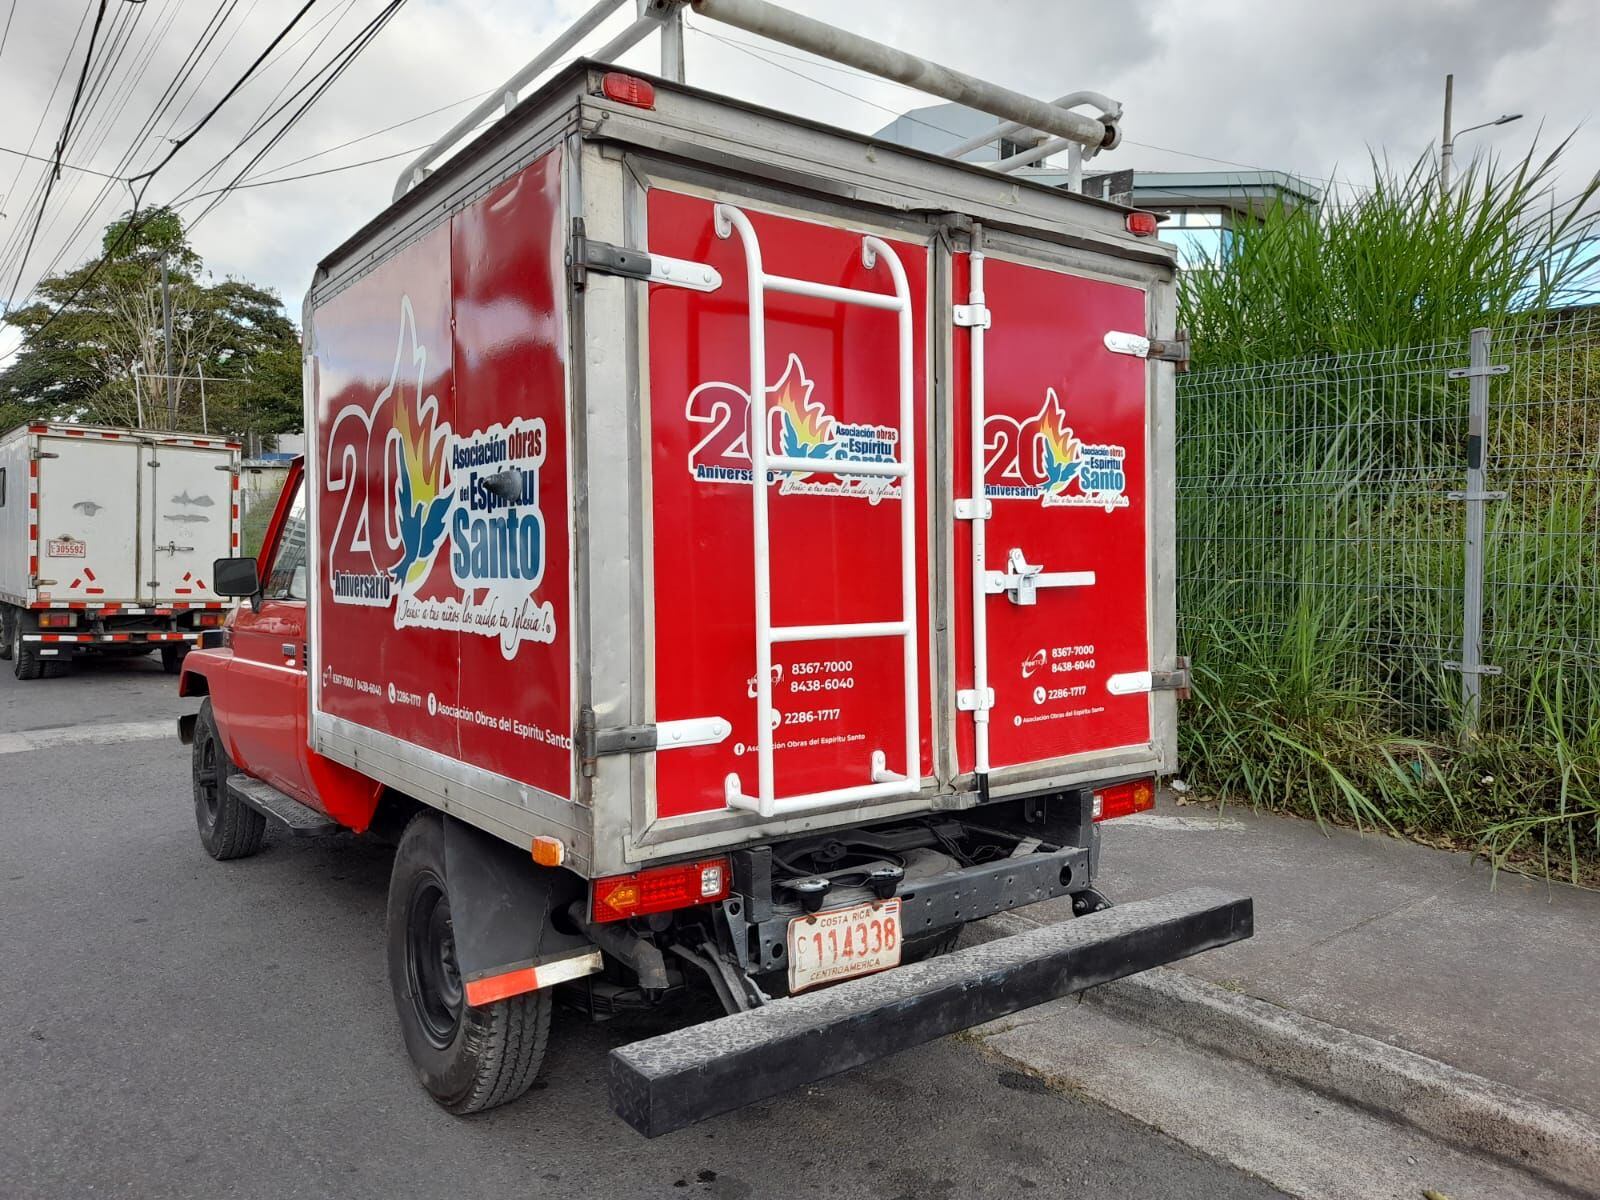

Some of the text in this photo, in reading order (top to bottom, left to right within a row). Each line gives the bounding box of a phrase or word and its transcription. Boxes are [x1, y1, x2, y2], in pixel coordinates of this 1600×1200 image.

[835, 425, 896, 441] Asociación obras
[453, 427, 542, 470] Asociación obras
[849, 438, 892, 455] Espíritu
[1090, 457, 1121, 470] Espíritu
[1081, 466, 1123, 490] Santo
[460, 465, 534, 513] del Espu
[985, 484, 1038, 497] Aniversario
[453, 507, 541, 580] Santo
[335, 570, 390, 600] Aniversario
[423, 609, 429, 619] a
[442, 605, 460, 623] niños
[462, 595, 473, 624] los
[475, 596, 498, 628] cuida
[500, 609, 509, 628] tu
[505, 598, 542, 650] Iglesia
[1051, 645, 1094, 658] 8367-7000
[791, 661, 853, 675] 8367-7000
[1051, 659, 1095, 673] 8438-6040
[790, 677, 854, 692] 8438-6040
[1047, 685, 1087, 700] 2286-1717
[438, 700, 572, 750] Asociación Obras del Espíritu Santo
[784, 709, 840, 724] 2286-1717
[787, 739, 808, 748] Obras
[809, 737, 820, 746] del
[821, 735, 846, 746] Espíritu
[847, 733, 866, 742] Santo
[820, 908, 871, 928] COSTA RICA
[812, 916, 896, 967] 114338
[810, 958, 880, 981] CENTROAMERICA
